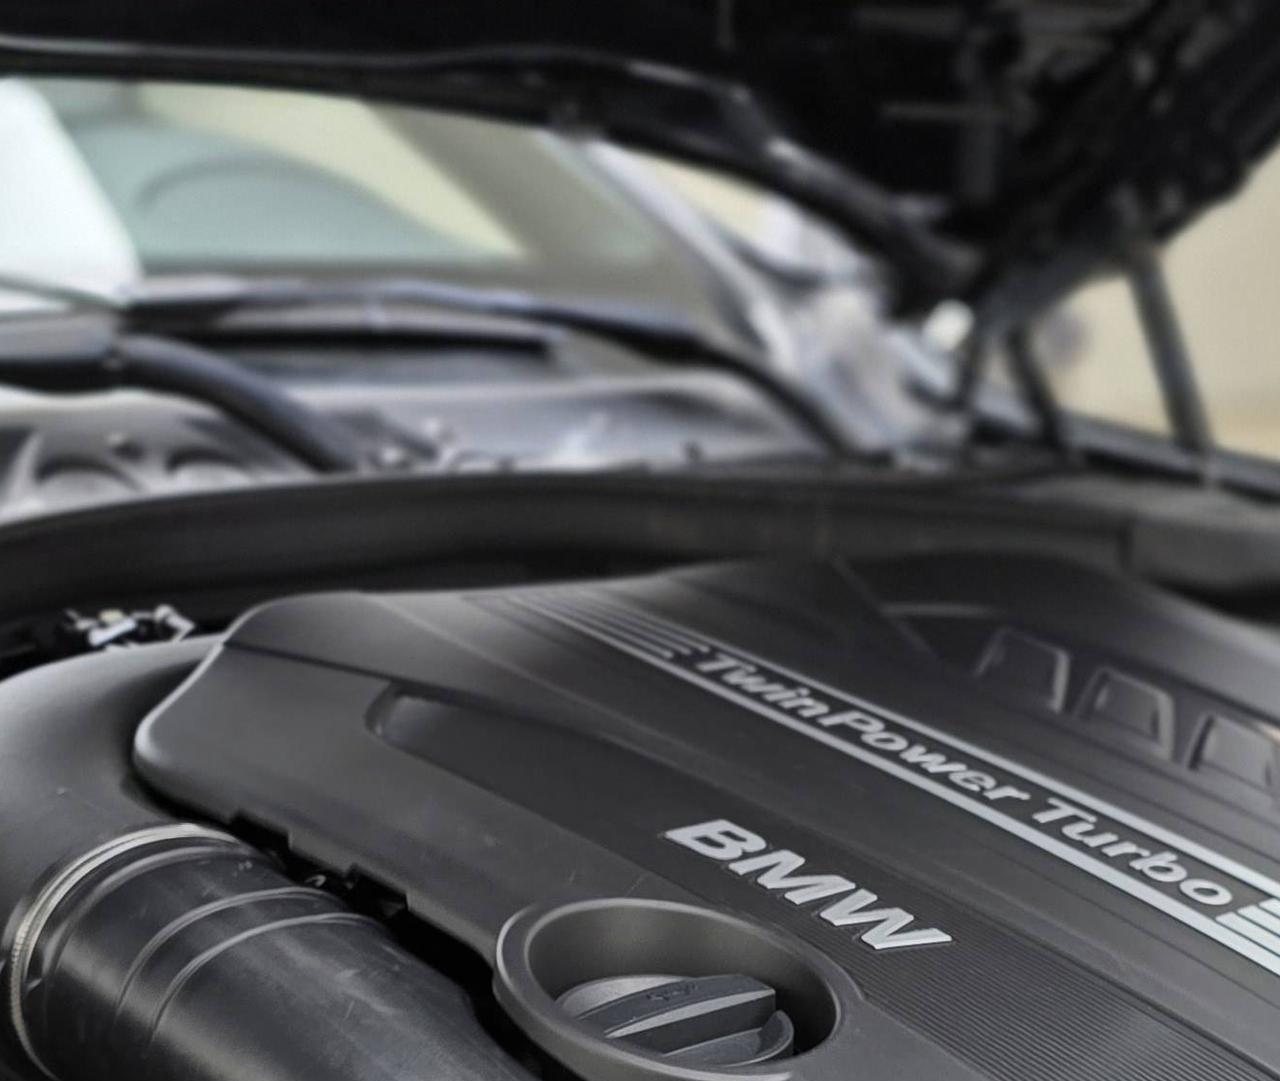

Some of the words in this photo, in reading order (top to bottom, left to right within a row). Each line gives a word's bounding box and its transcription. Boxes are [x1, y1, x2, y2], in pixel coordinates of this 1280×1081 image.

[696, 652, 1031, 801] TwinPower
[1031, 797, 1234, 906] Turbo
[665, 818, 953, 950] BMW
